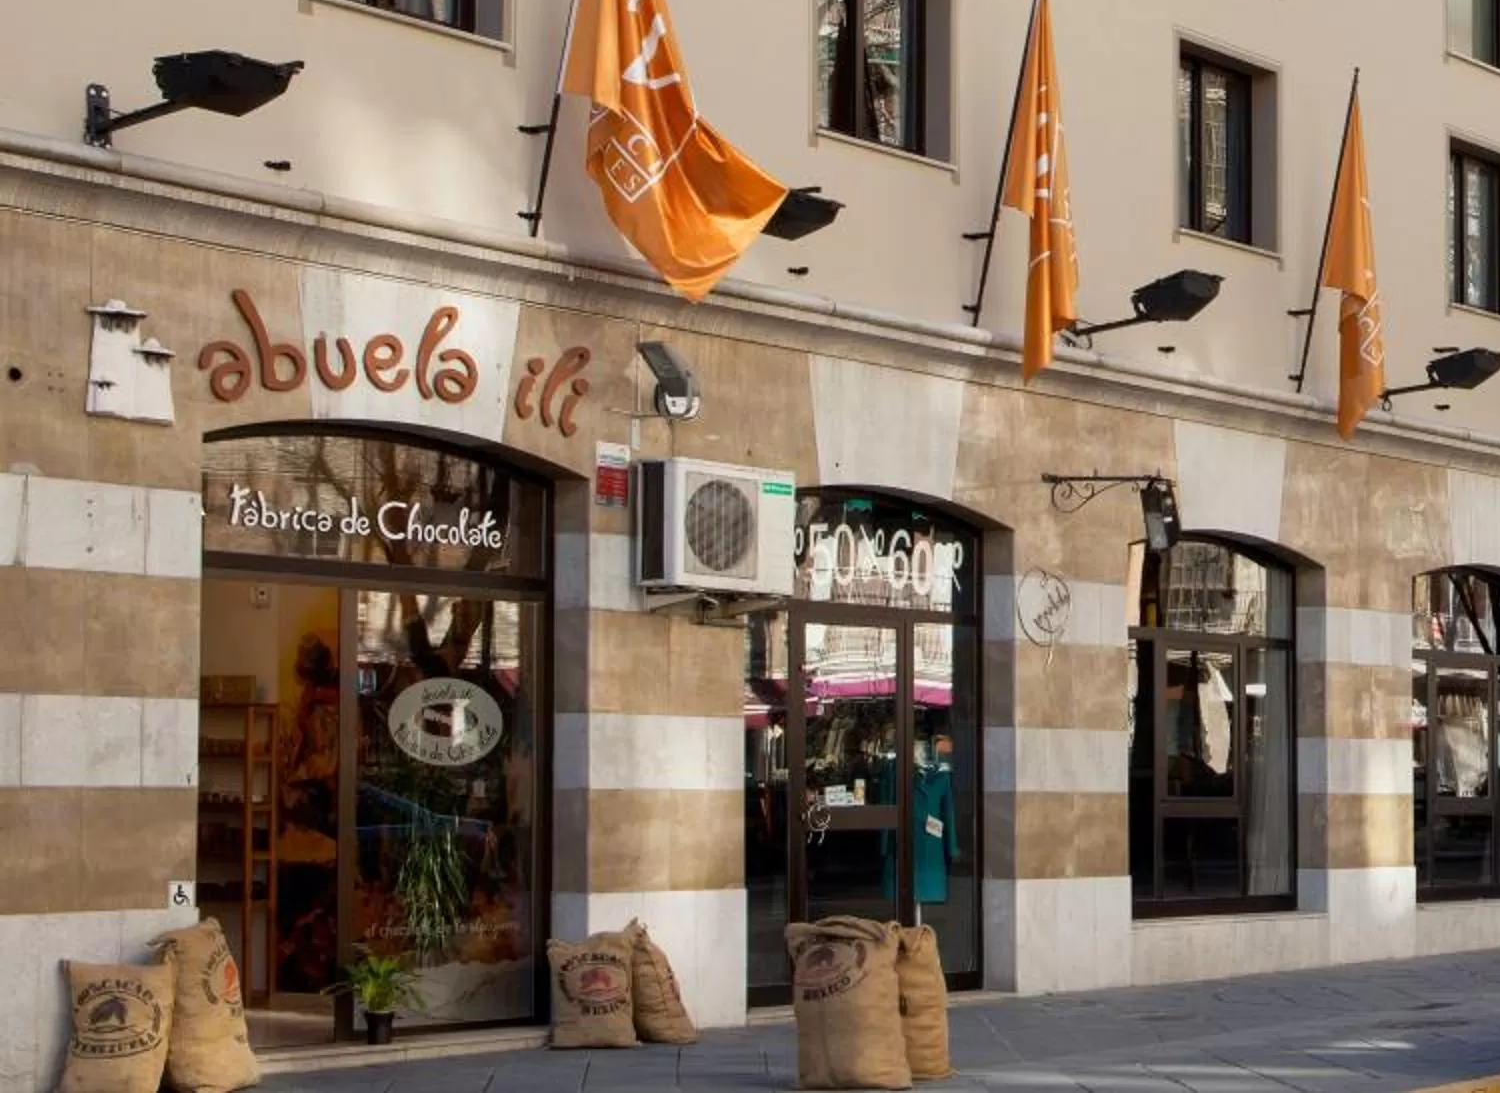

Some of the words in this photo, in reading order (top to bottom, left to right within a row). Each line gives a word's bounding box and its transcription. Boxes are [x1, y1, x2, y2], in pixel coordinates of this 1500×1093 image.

[198, 288, 480, 404] abuela
[339, 496, 371, 536] de
[377, 500, 502, 549] Chocolate
